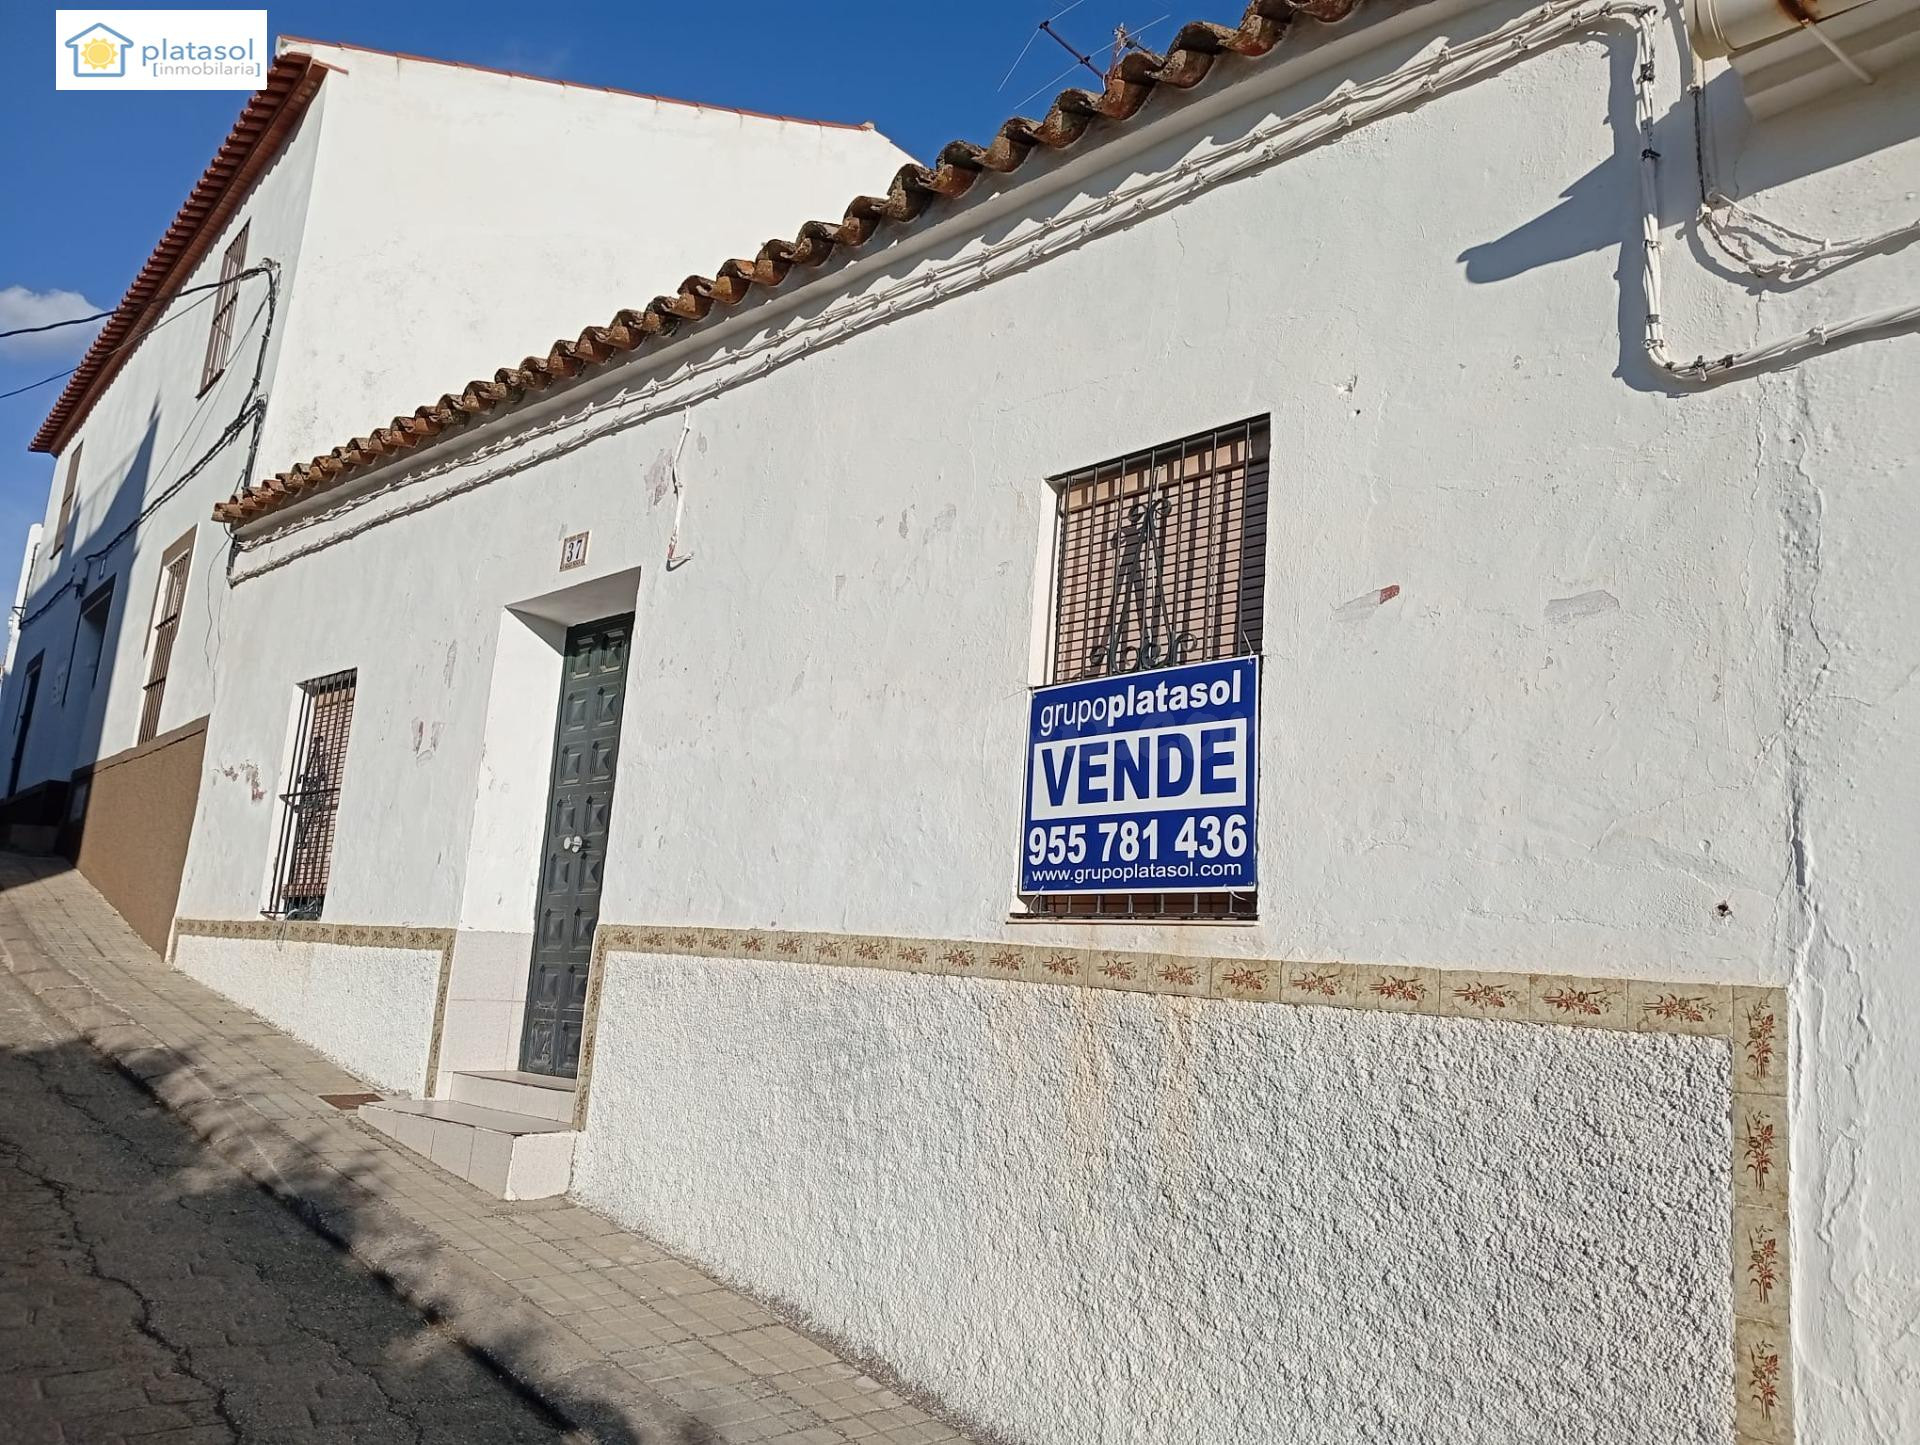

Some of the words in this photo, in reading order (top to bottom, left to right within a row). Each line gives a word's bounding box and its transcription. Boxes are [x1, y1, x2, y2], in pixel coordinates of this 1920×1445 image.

[566, 539, 583, 563] 37
[1040, 669, 1241, 737] grupoplatasol
[1041, 726, 1237, 807] VENDE
[1028, 824, 1086, 866] 955
[1098, 818, 1158, 862] 781
[1174, 814, 1247, 859] 436
[1031, 861, 1242, 884] www.grupoplatasol.com
